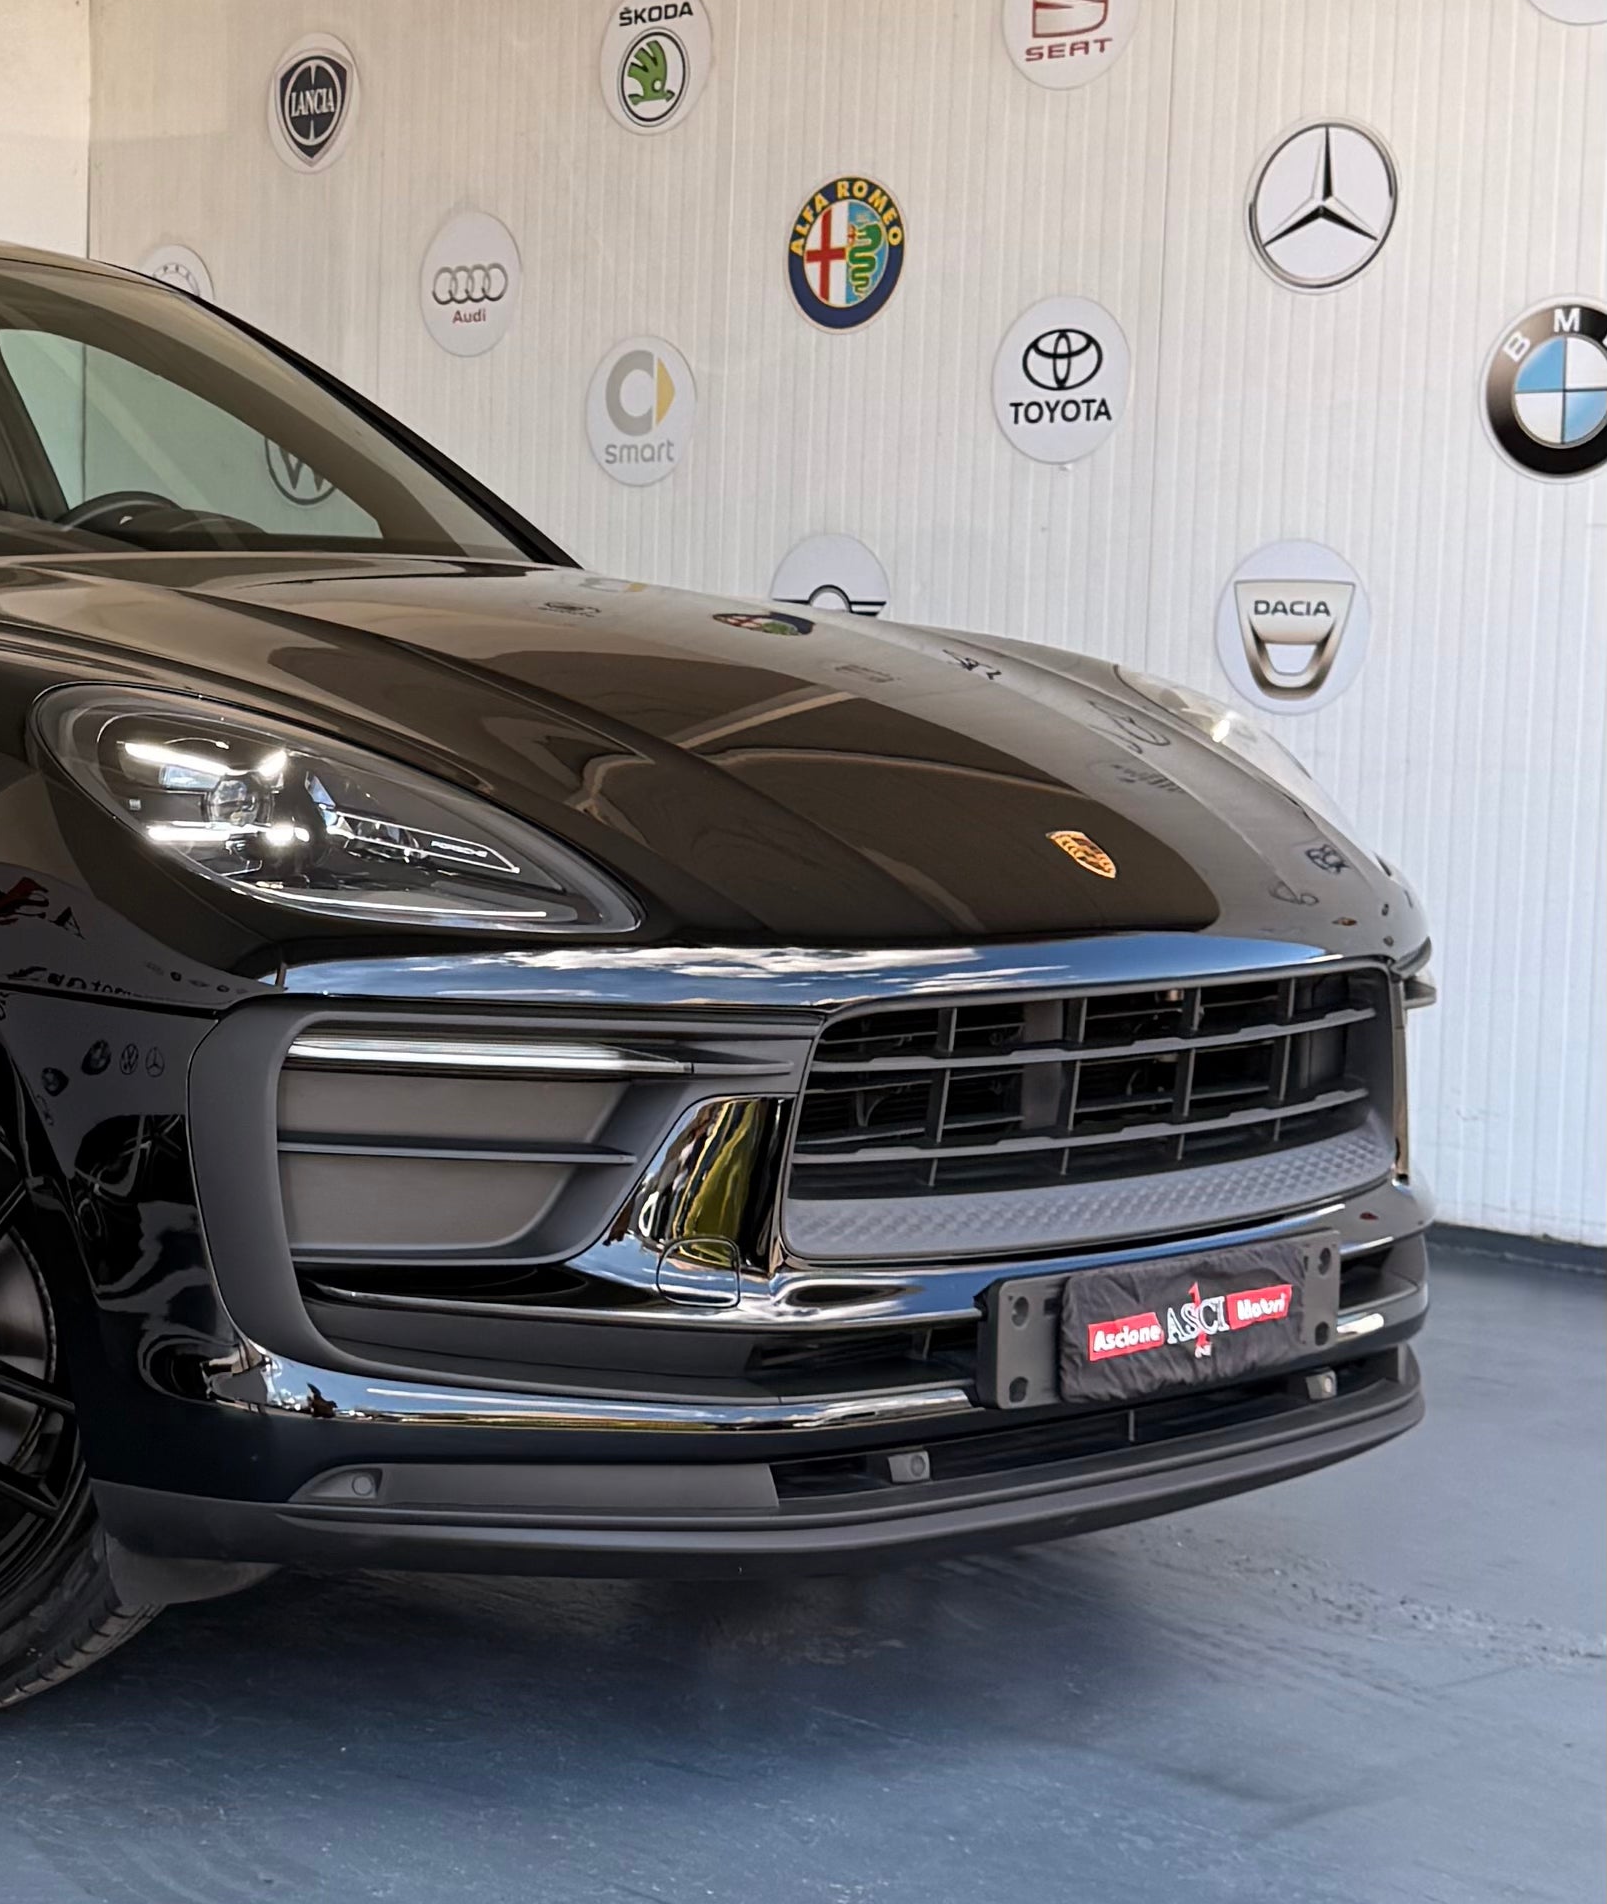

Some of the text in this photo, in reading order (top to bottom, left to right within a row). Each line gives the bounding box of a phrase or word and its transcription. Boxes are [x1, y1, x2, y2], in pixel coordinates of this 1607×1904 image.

[619, 1, 693, 27] ŠKODA
[1025, 37, 1113, 62] SEAT
[290, 87, 335, 117] LANCIA
[790, 180, 903, 257] ALFA ROMEO
[452, 308, 486, 324] Audi
[1502, 307, 1607, 363] BM
[1009, 397, 1113, 424] TOYOTA
[604, 438, 675, 464] smart
[1253, 599, 1331, 617] DACIA
[1093, 1324, 1163, 1353] Ascione
[1166, 1296, 1231, 1345] ASCI
